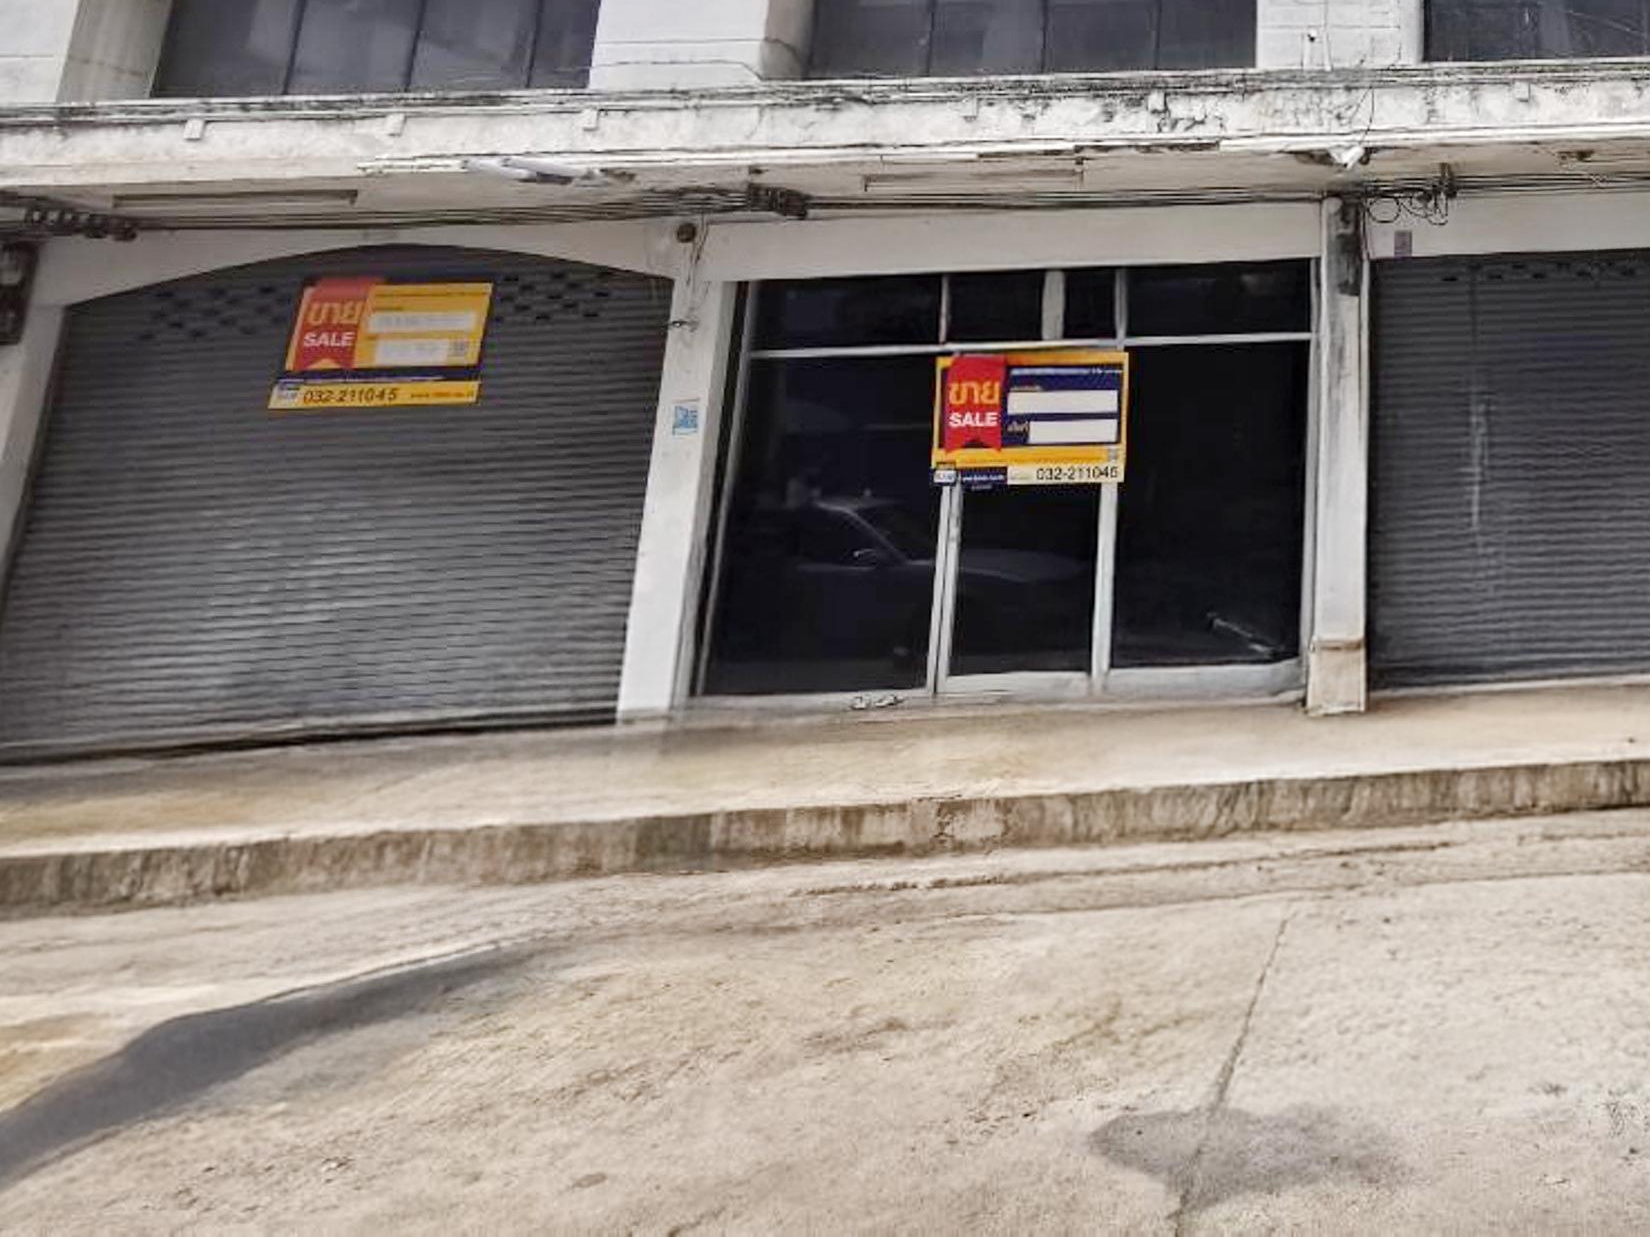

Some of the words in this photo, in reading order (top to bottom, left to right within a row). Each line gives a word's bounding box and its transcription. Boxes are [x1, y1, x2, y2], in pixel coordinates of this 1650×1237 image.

[304, 331, 354, 347] SALE
[949, 381, 1000, 405] ขาย
[949, 412, 998, 427] SALE
